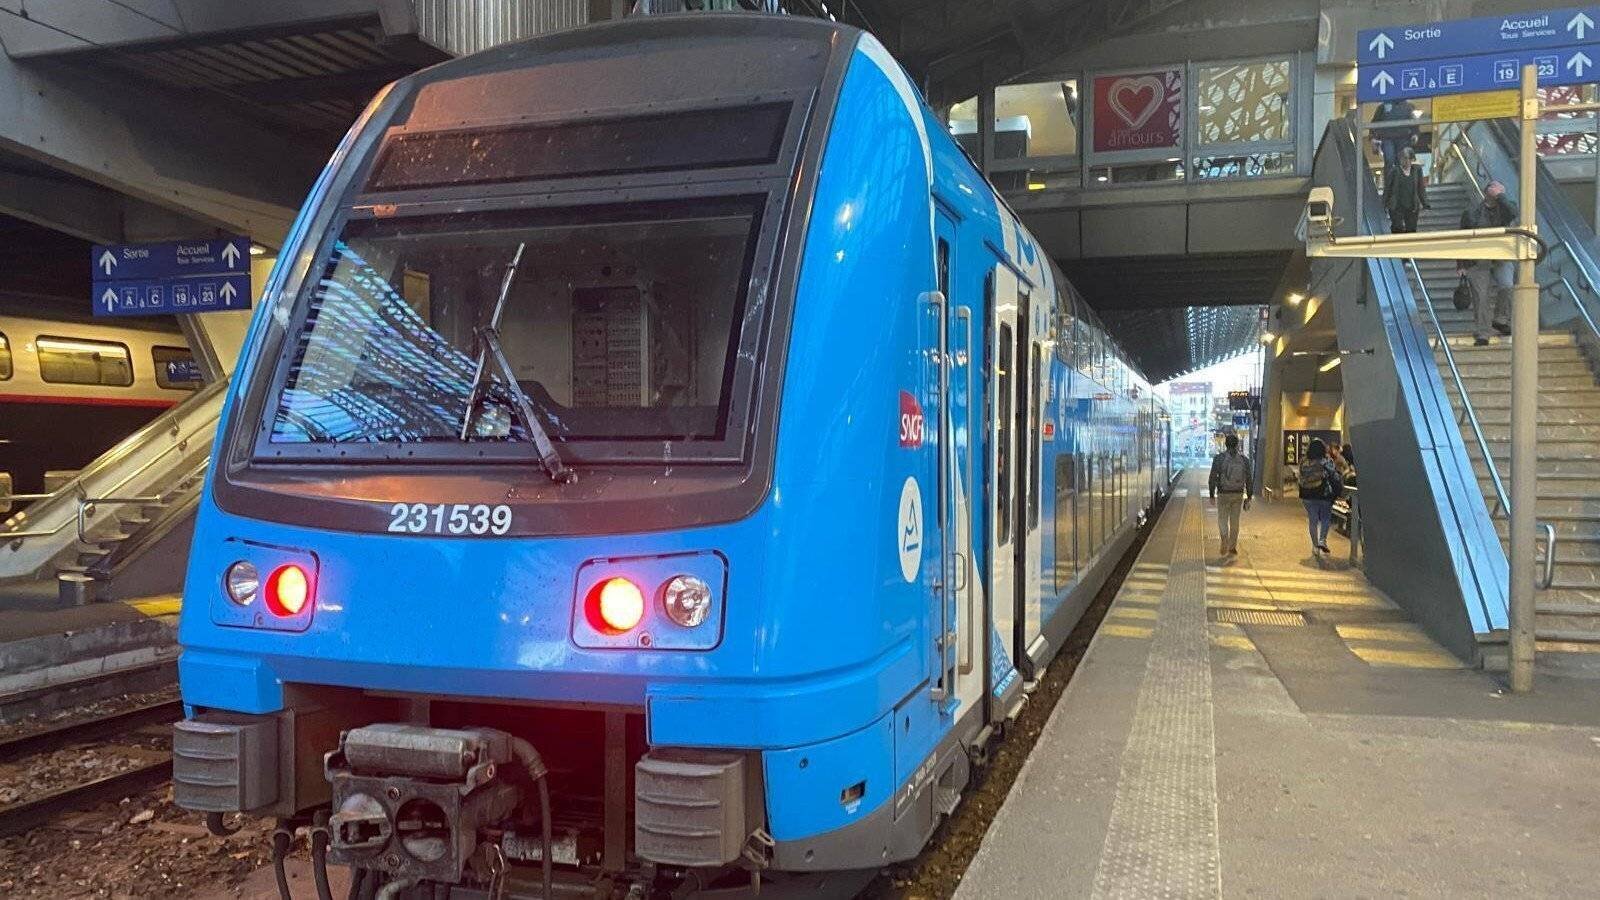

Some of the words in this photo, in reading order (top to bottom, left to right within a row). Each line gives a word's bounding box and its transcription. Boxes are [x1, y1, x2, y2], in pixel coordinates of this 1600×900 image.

[1500, 15, 1549, 31] Accueil
[1404, 28, 1441, 41] Sortie
[1500, 32, 1519, 40] Tous
[1522, 29, 1556, 38] Services
[1408, 77, 1419, 88] A
[1446, 73, 1456, 84] E
[1498, 68, 1514, 80] 19
[1538, 64, 1554, 76] 23
[176, 243, 210, 256] Accueil
[126, 295, 133, 306] A
[151, 294, 159, 305] C
[176, 293, 187, 304] 19
[202, 291, 214, 302] 23
[900, 413, 923, 442] SNCF
[388, 503, 513, 535] 231539
